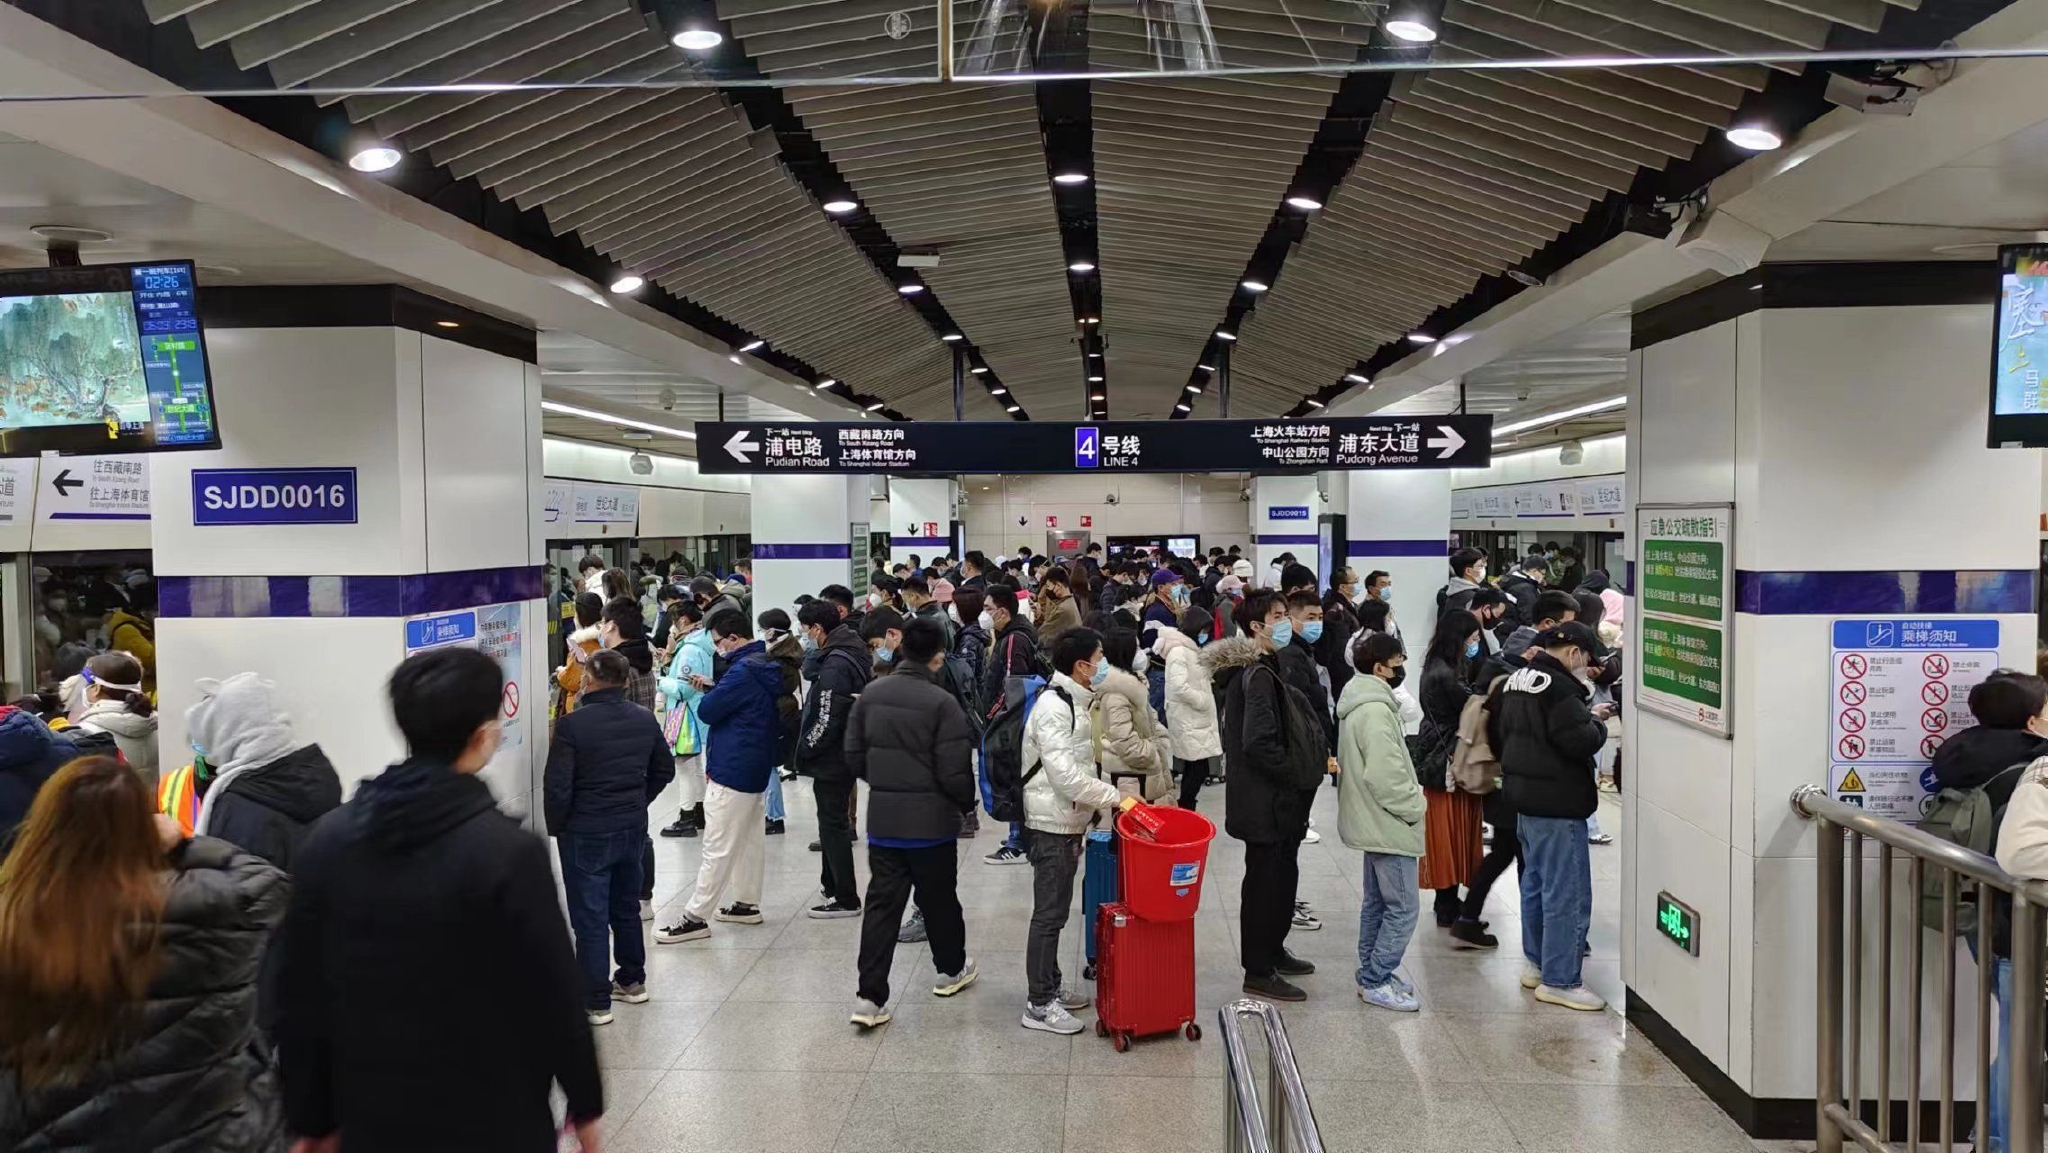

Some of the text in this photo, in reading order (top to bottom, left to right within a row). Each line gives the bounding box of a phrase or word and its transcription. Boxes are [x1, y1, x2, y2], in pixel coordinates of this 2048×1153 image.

[145, 275, 179, 289] 02:26
[765, 427, 789, 436] 下一站
[1250, 425, 1330, 438] 上海火车站方向
[1394, 422, 1420, 432] 下一站
[838, 429, 904, 440] 西藏南路方向
[765, 436, 822, 456] 浦电路
[1078, 435, 1141, 460] 4 号线
[1339, 432, 1419, 454] 浦东大道
[839, 449, 917, 460] 上海体育馆方向
[1262, 446, 1330, 458] 中山公园方向
[94, 459, 142, 474] 往西藏南路
[765, 457, 830, 466] Pudian Road
[1103, 457, 1138, 466] LINE 4
[1336, 454, 1418, 466] Pudong Avenue
[90, 487, 149, 502] 往上海体育馆
[204, 484, 345, 509] SJDD0016
[1650, 516, 1718, 537] 应急公交疏散指引
[1902, 622, 1932, 630] 自动扶梯
[1901, 629, 1957, 643] 乘梯须知
